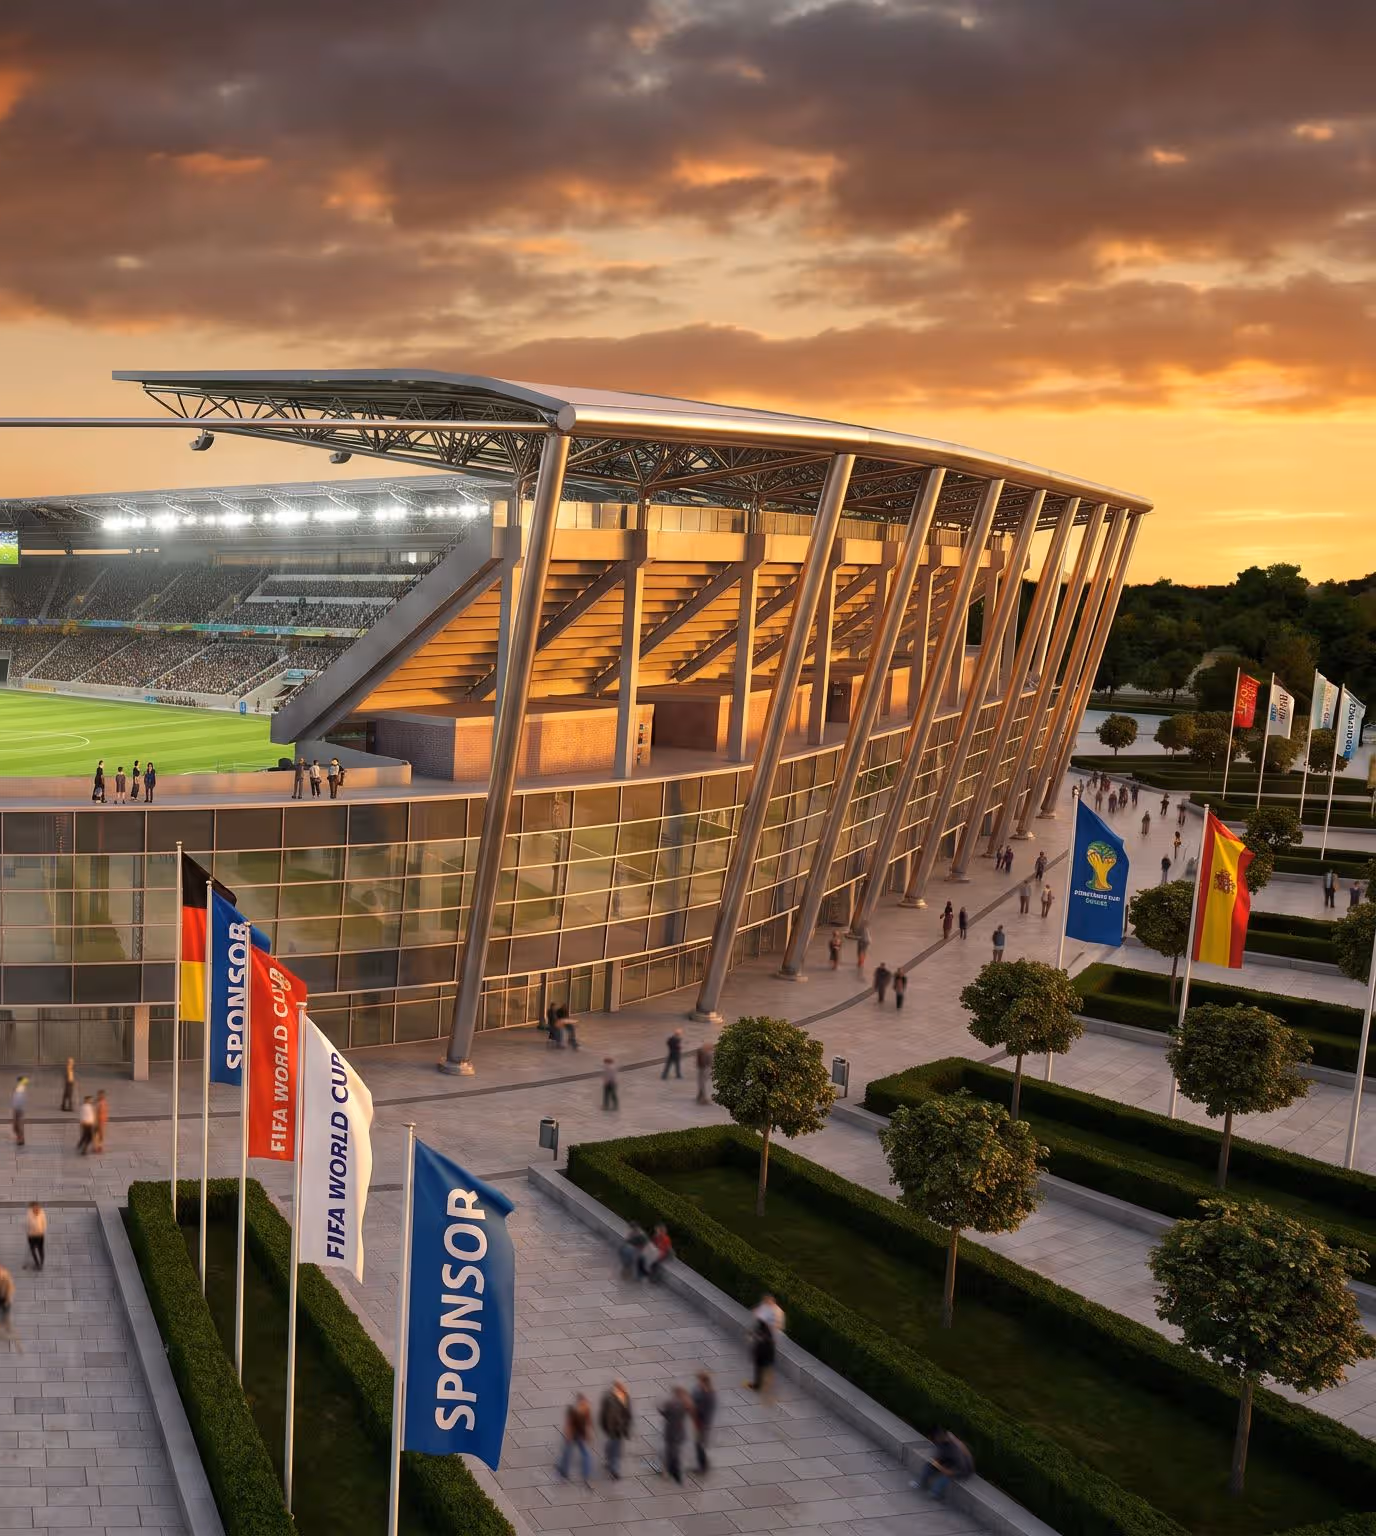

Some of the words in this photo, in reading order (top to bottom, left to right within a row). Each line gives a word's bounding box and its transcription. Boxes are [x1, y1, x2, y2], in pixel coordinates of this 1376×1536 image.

[273, 1024, 289, 1102] WORLD
[330, 1052, 349, 1104] CUP
[270, 1107, 289, 1152] FIFA
[329, 1111, 349, 1200] WORLD
[326, 1208, 346, 1260] FIFA
[435, 1187, 488, 1432] SPONSOR
